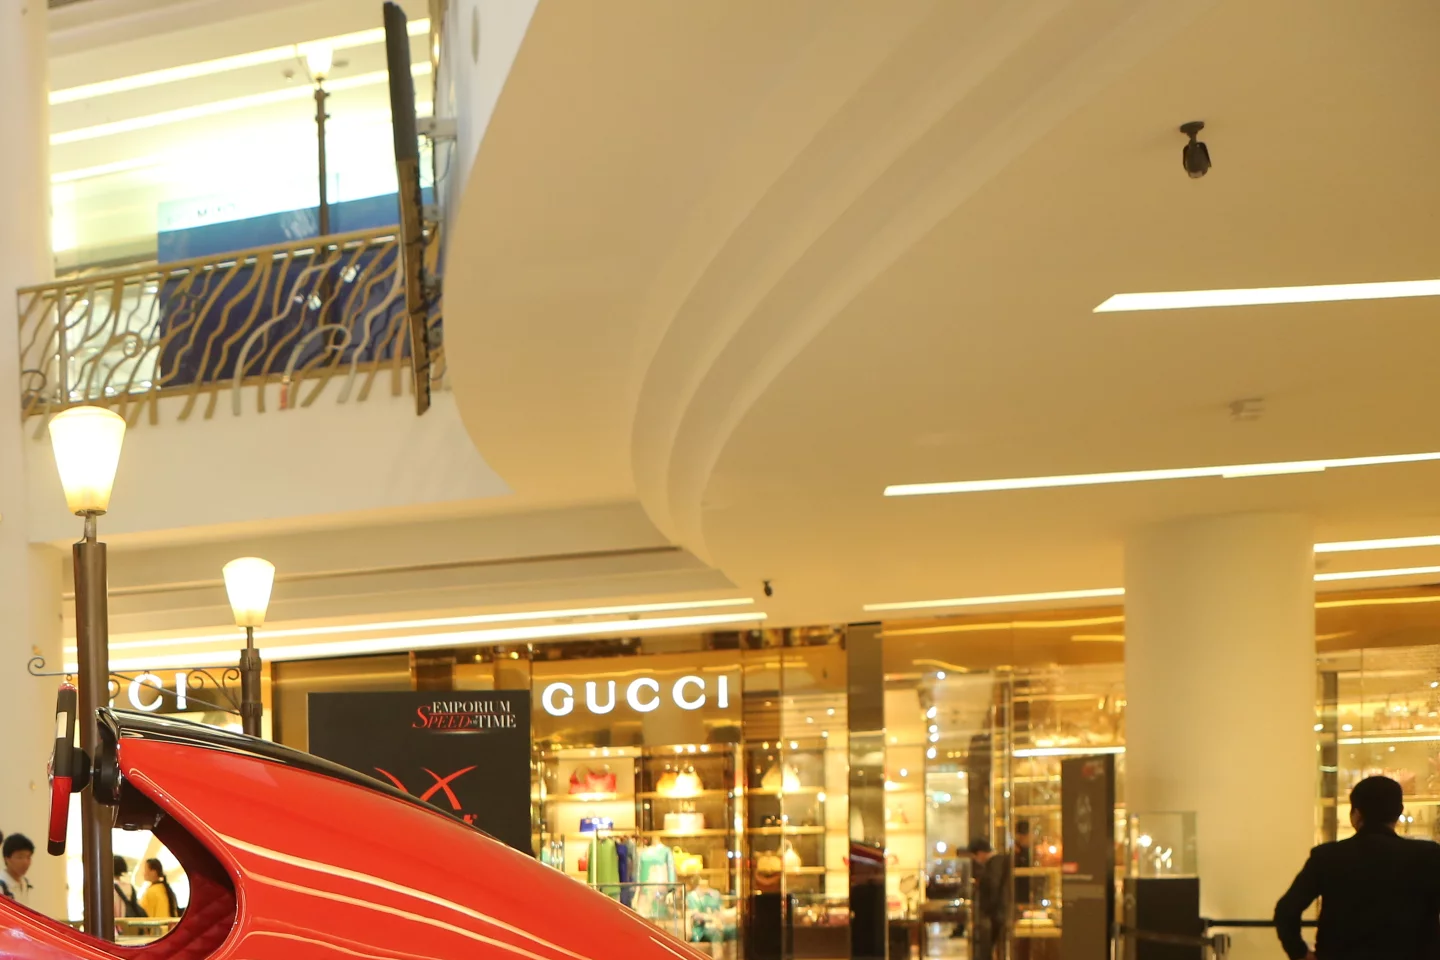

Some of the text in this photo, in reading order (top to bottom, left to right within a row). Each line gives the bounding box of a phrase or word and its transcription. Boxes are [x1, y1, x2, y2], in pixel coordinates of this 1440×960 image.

[542, 675, 729, 717] GUCCI
[433, 700, 510, 714] EMPORIUM
[475, 714, 517, 728] TIME
